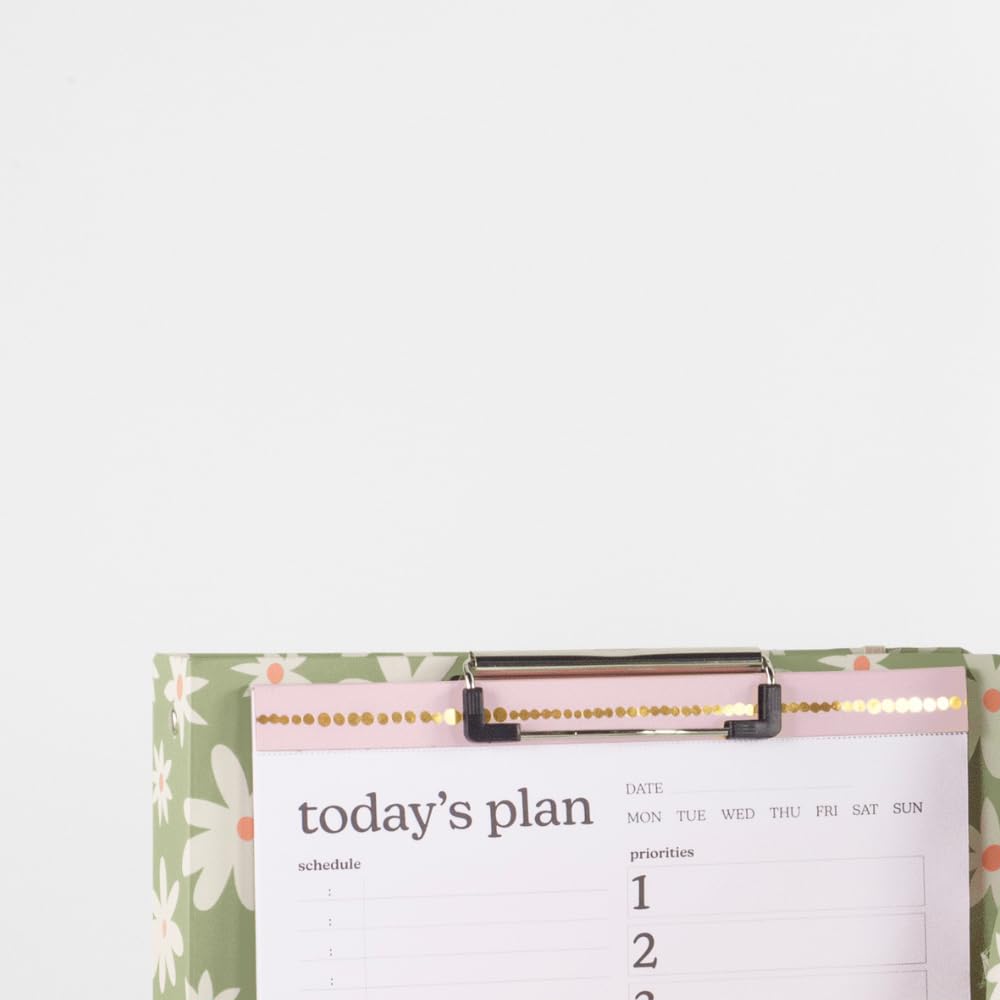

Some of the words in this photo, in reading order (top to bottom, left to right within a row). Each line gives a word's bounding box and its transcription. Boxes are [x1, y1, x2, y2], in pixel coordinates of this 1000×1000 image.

[626, 783, 664, 795] DATE
[486, 787, 594, 839] plan
[627, 811, 662, 824] MON
[676, 810, 707, 823] TUE
[721, 808, 756, 821] WED
[769, 806, 801, 819] THU
[815, 805, 838, 817] FRI
[852, 803, 879, 816] SAT
[893, 801, 923, 815] SUN
[298, 858, 361, 872] schedule
[630, 847, 695, 863] priorities
[632, 875, 651, 910] 1
[632, 932, 658, 969] 2
